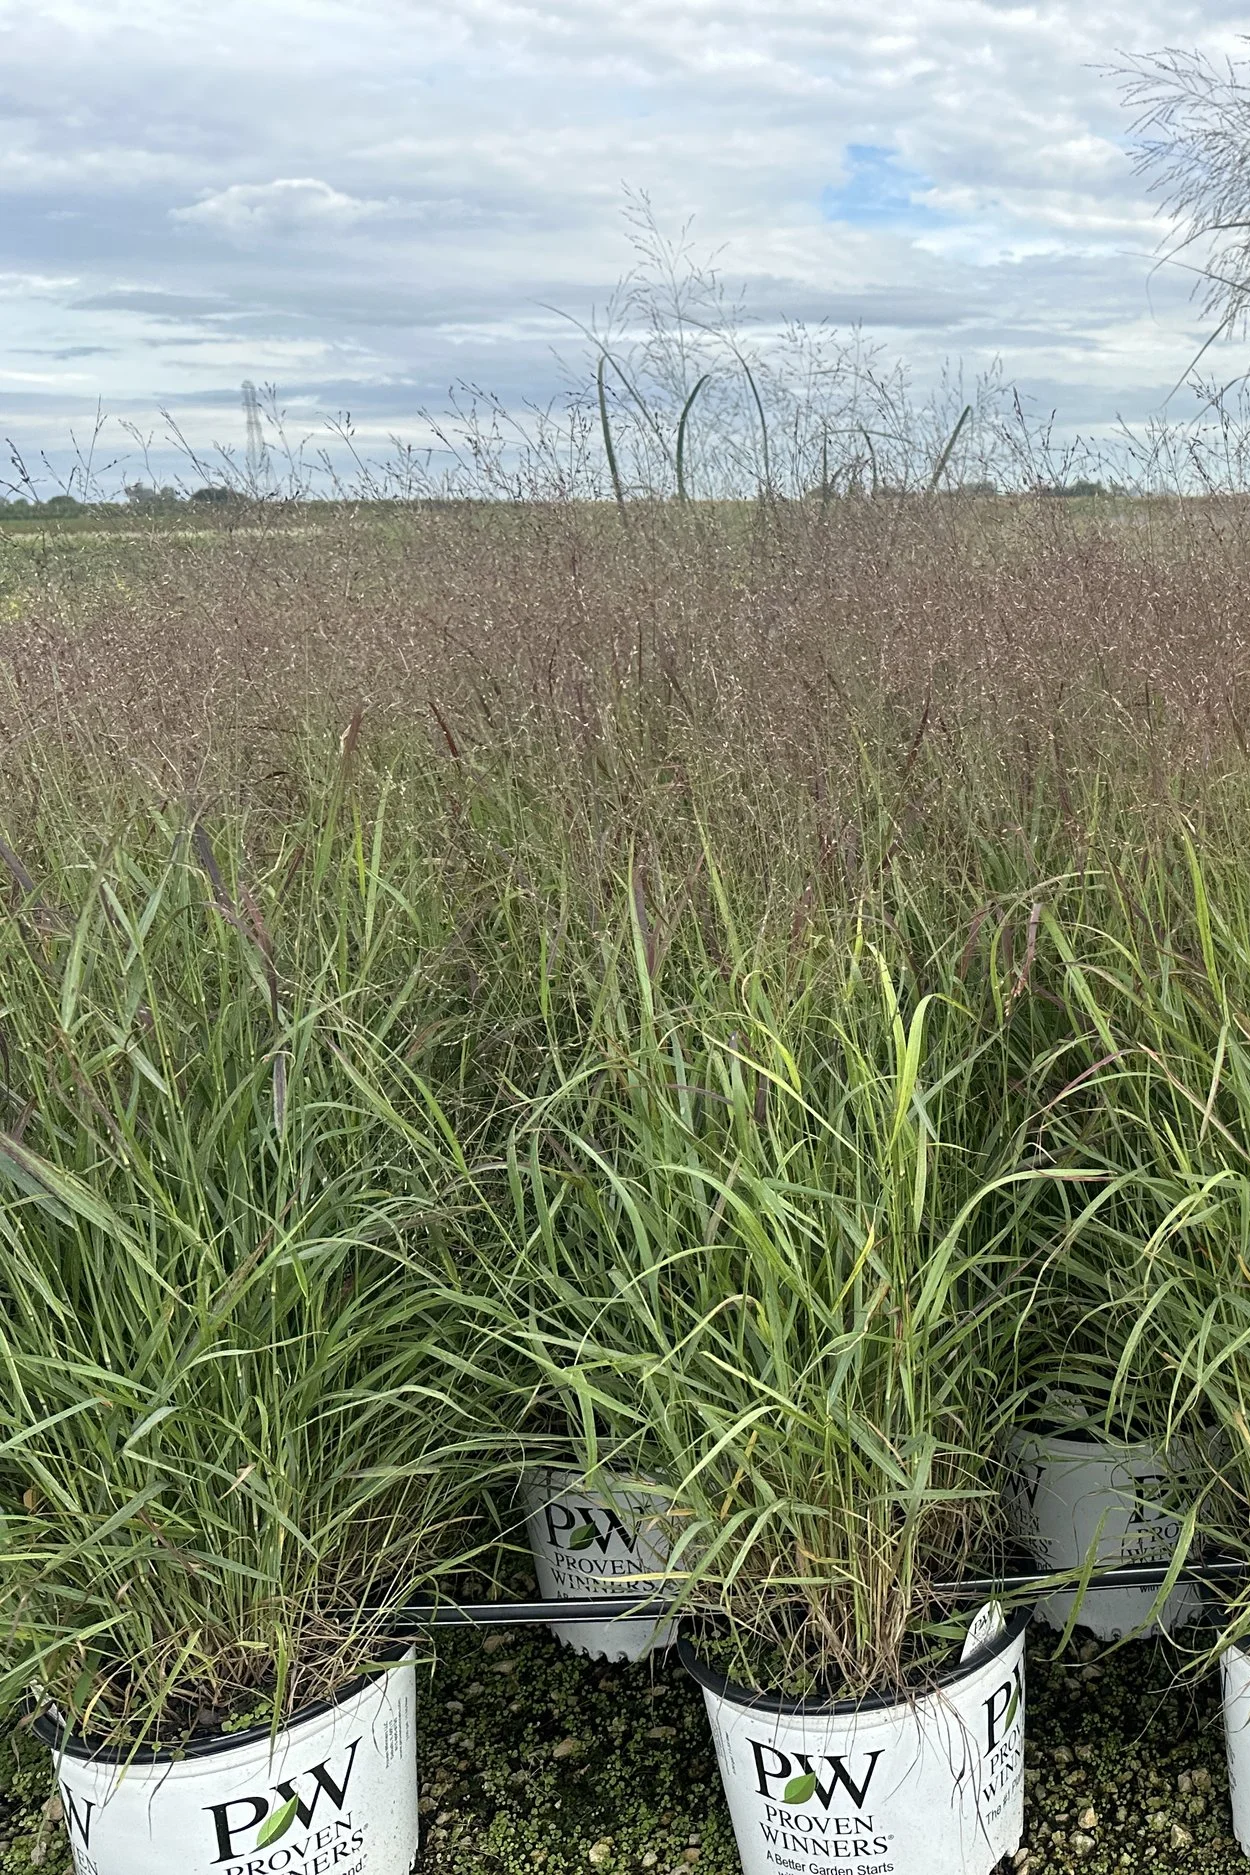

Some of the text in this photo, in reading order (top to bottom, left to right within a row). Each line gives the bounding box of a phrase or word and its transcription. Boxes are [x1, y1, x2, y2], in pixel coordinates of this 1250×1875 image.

[538, 1497, 651, 1555] PW
[554, 1552, 644, 1575] PROVEN
[745, 1737, 886, 1811] PW
[201, 1735, 363, 1865] PW
[764, 1803, 874, 1835] PROVEN
[766, 1850, 894, 1875] A Better Garden Starts
